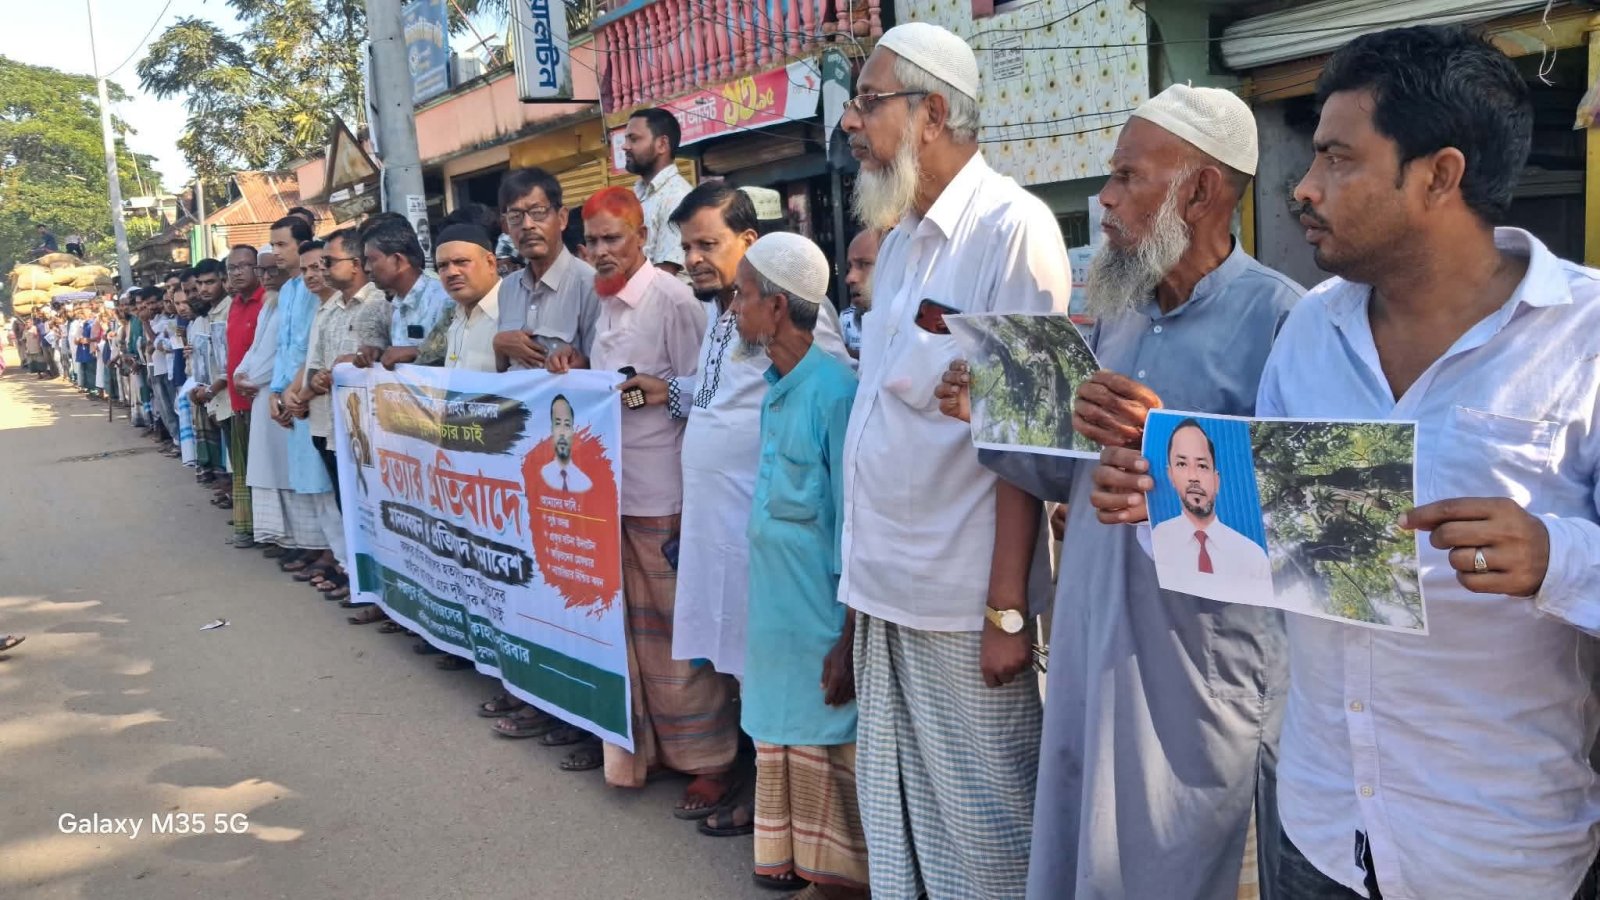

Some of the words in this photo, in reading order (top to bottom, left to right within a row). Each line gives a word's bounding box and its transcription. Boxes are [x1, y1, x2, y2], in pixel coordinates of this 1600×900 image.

[461, 421, 485, 446] চাই
[376, 447, 424, 500] হত্যার
[427, 449, 523, 538] প্রতিবাদে
